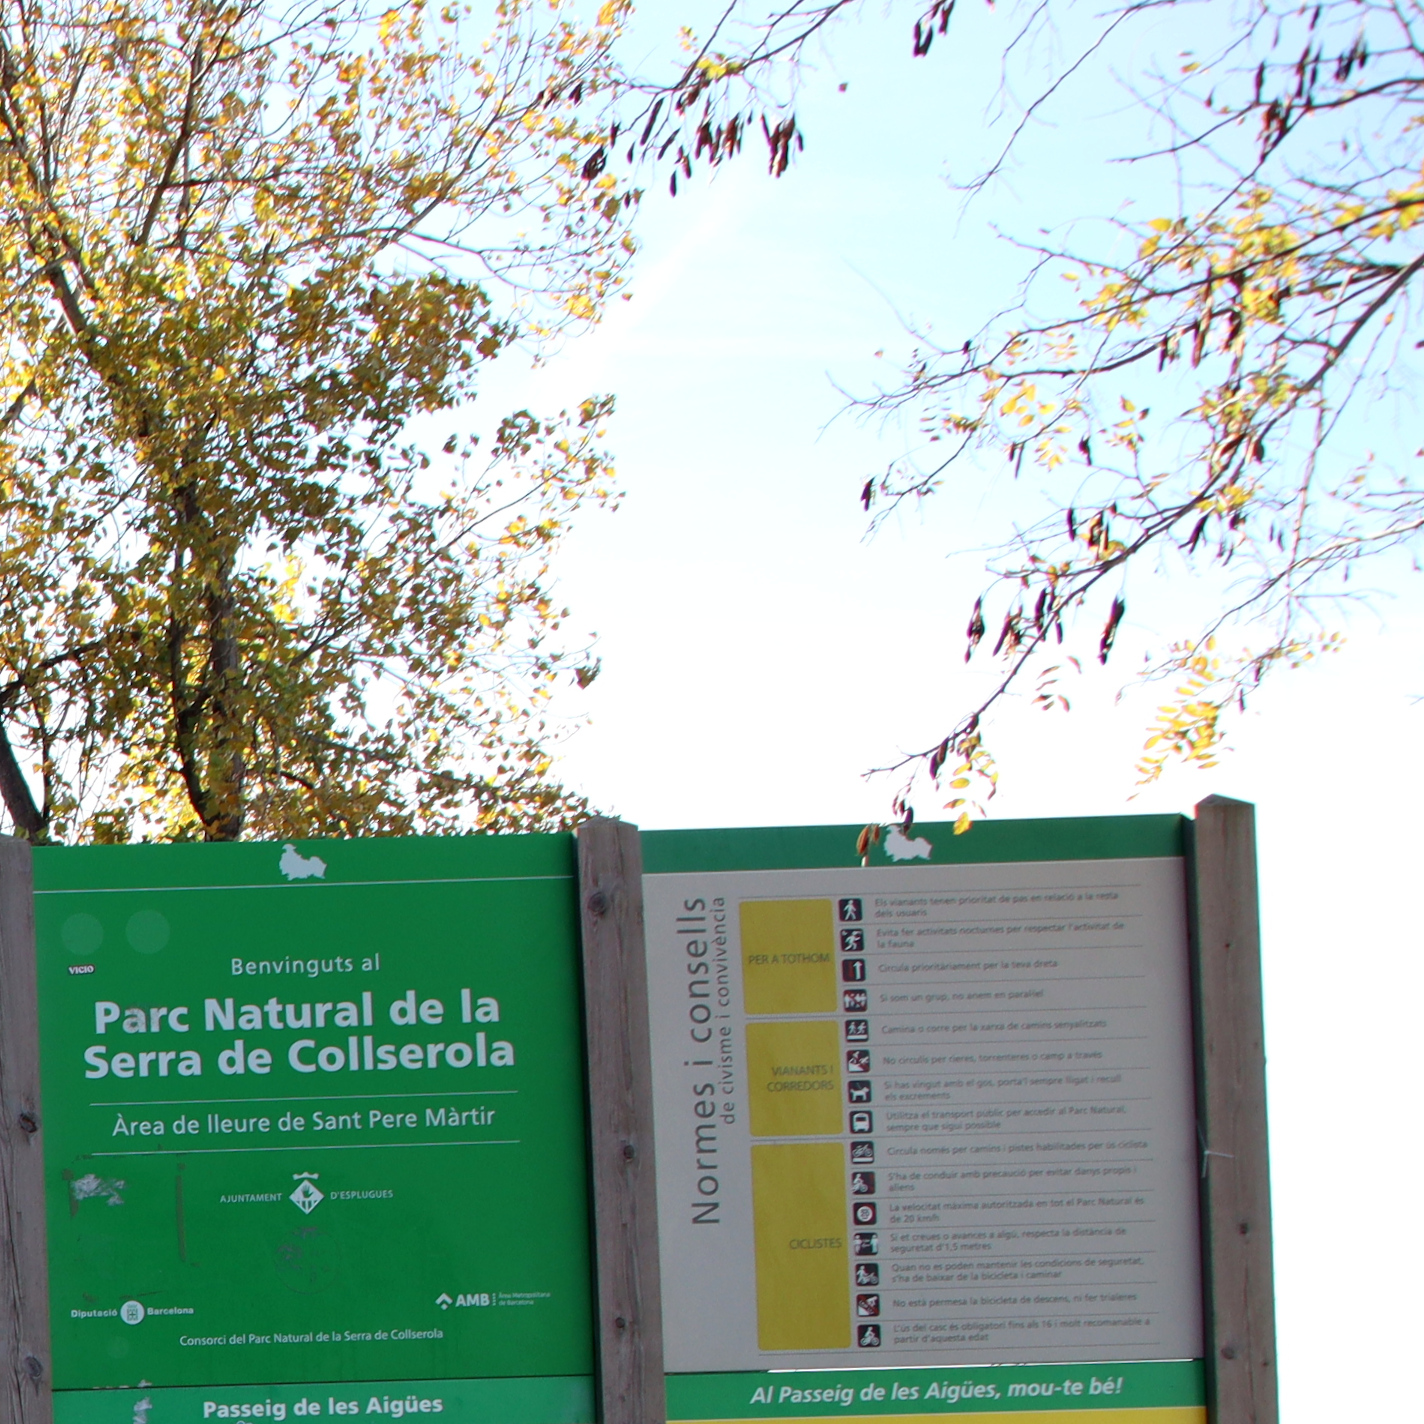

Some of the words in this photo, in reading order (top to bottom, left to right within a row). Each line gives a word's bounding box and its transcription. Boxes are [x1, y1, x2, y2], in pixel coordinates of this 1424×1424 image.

[709, 897, 731, 1008] convivència
[748, 954, 769, 965] PER
[781, 952, 830, 963] TOTHOM
[68, 964, 94, 974] VICIO
[231, 956, 353, 977] Benvinguts
[361, 952, 380, 971] al
[675, 897, 713, 1043] consells
[95, 1001, 189, 1033] Parc
[204, 992, 373, 1029] Natural
[389, 990, 444, 1024] de
[461, 988, 499, 1022] la
[84, 1045, 202, 1078] Serra
[217, 1039, 272, 1074] de
[288, 1033, 515, 1071] Collserola
[683, 1059, 714, 1067] i
[715, 1026, 735, 1095] civisme
[771, 1064, 828, 1076] VIANANTS
[766, 1080, 834, 1092] CORREDORS
[112, 1113, 164, 1135] Àrea
[172, 1114, 199, 1134] de
[207, 1114, 270, 1133] lleure
[277, 1111, 305, 1131] de
[312, 1111, 362, 1130] Sant
[369, 1109, 417, 1128] Pere
[425, 1106, 496, 1126] Màrtir
[720, 1102, 736, 1125] de
[690, 1082, 720, 1225] Normes
[219, 1192, 283, 1202] AJUNTAMENT
[330, 1189, 393, 1199] D'ESPLUGUES
[789, 1237, 842, 1249] CICLISTES
[455, 1293, 490, 1306] AMB
[70, 1308, 118, 1318] Diputació
[146, 1306, 194, 1315] Barcelona
[179, 1335, 226, 1346] Consorci
[228, 1333, 246, 1344] del
[248, 1333, 271, 1344] Parc
[273, 1332, 313, 1343] Natural
[315, 1331, 330, 1342] de
[331, 1331, 342, 1341] la
[343, 1330, 372, 1341] Serra
[373, 1329, 389, 1340] de
[390, 1328, 444, 1340] Collserola
[749, 1385, 774, 1404] Al
[778, 1385, 855, 1406] Passeig
[859, 1382, 886, 1401] de
[891, 1382, 920, 1400] les
[923, 1381, 1001, 1403] Aigües,
[1007, 1380, 1084, 1396] mou-te
[1088, 1376, 1124, 1394] bé!
[203, 1400, 286, 1422] Passeig
[293, 1398, 321, 1415] de
[328, 1397, 360, 1415] les
[365, 1395, 444, 1417] Aigües
